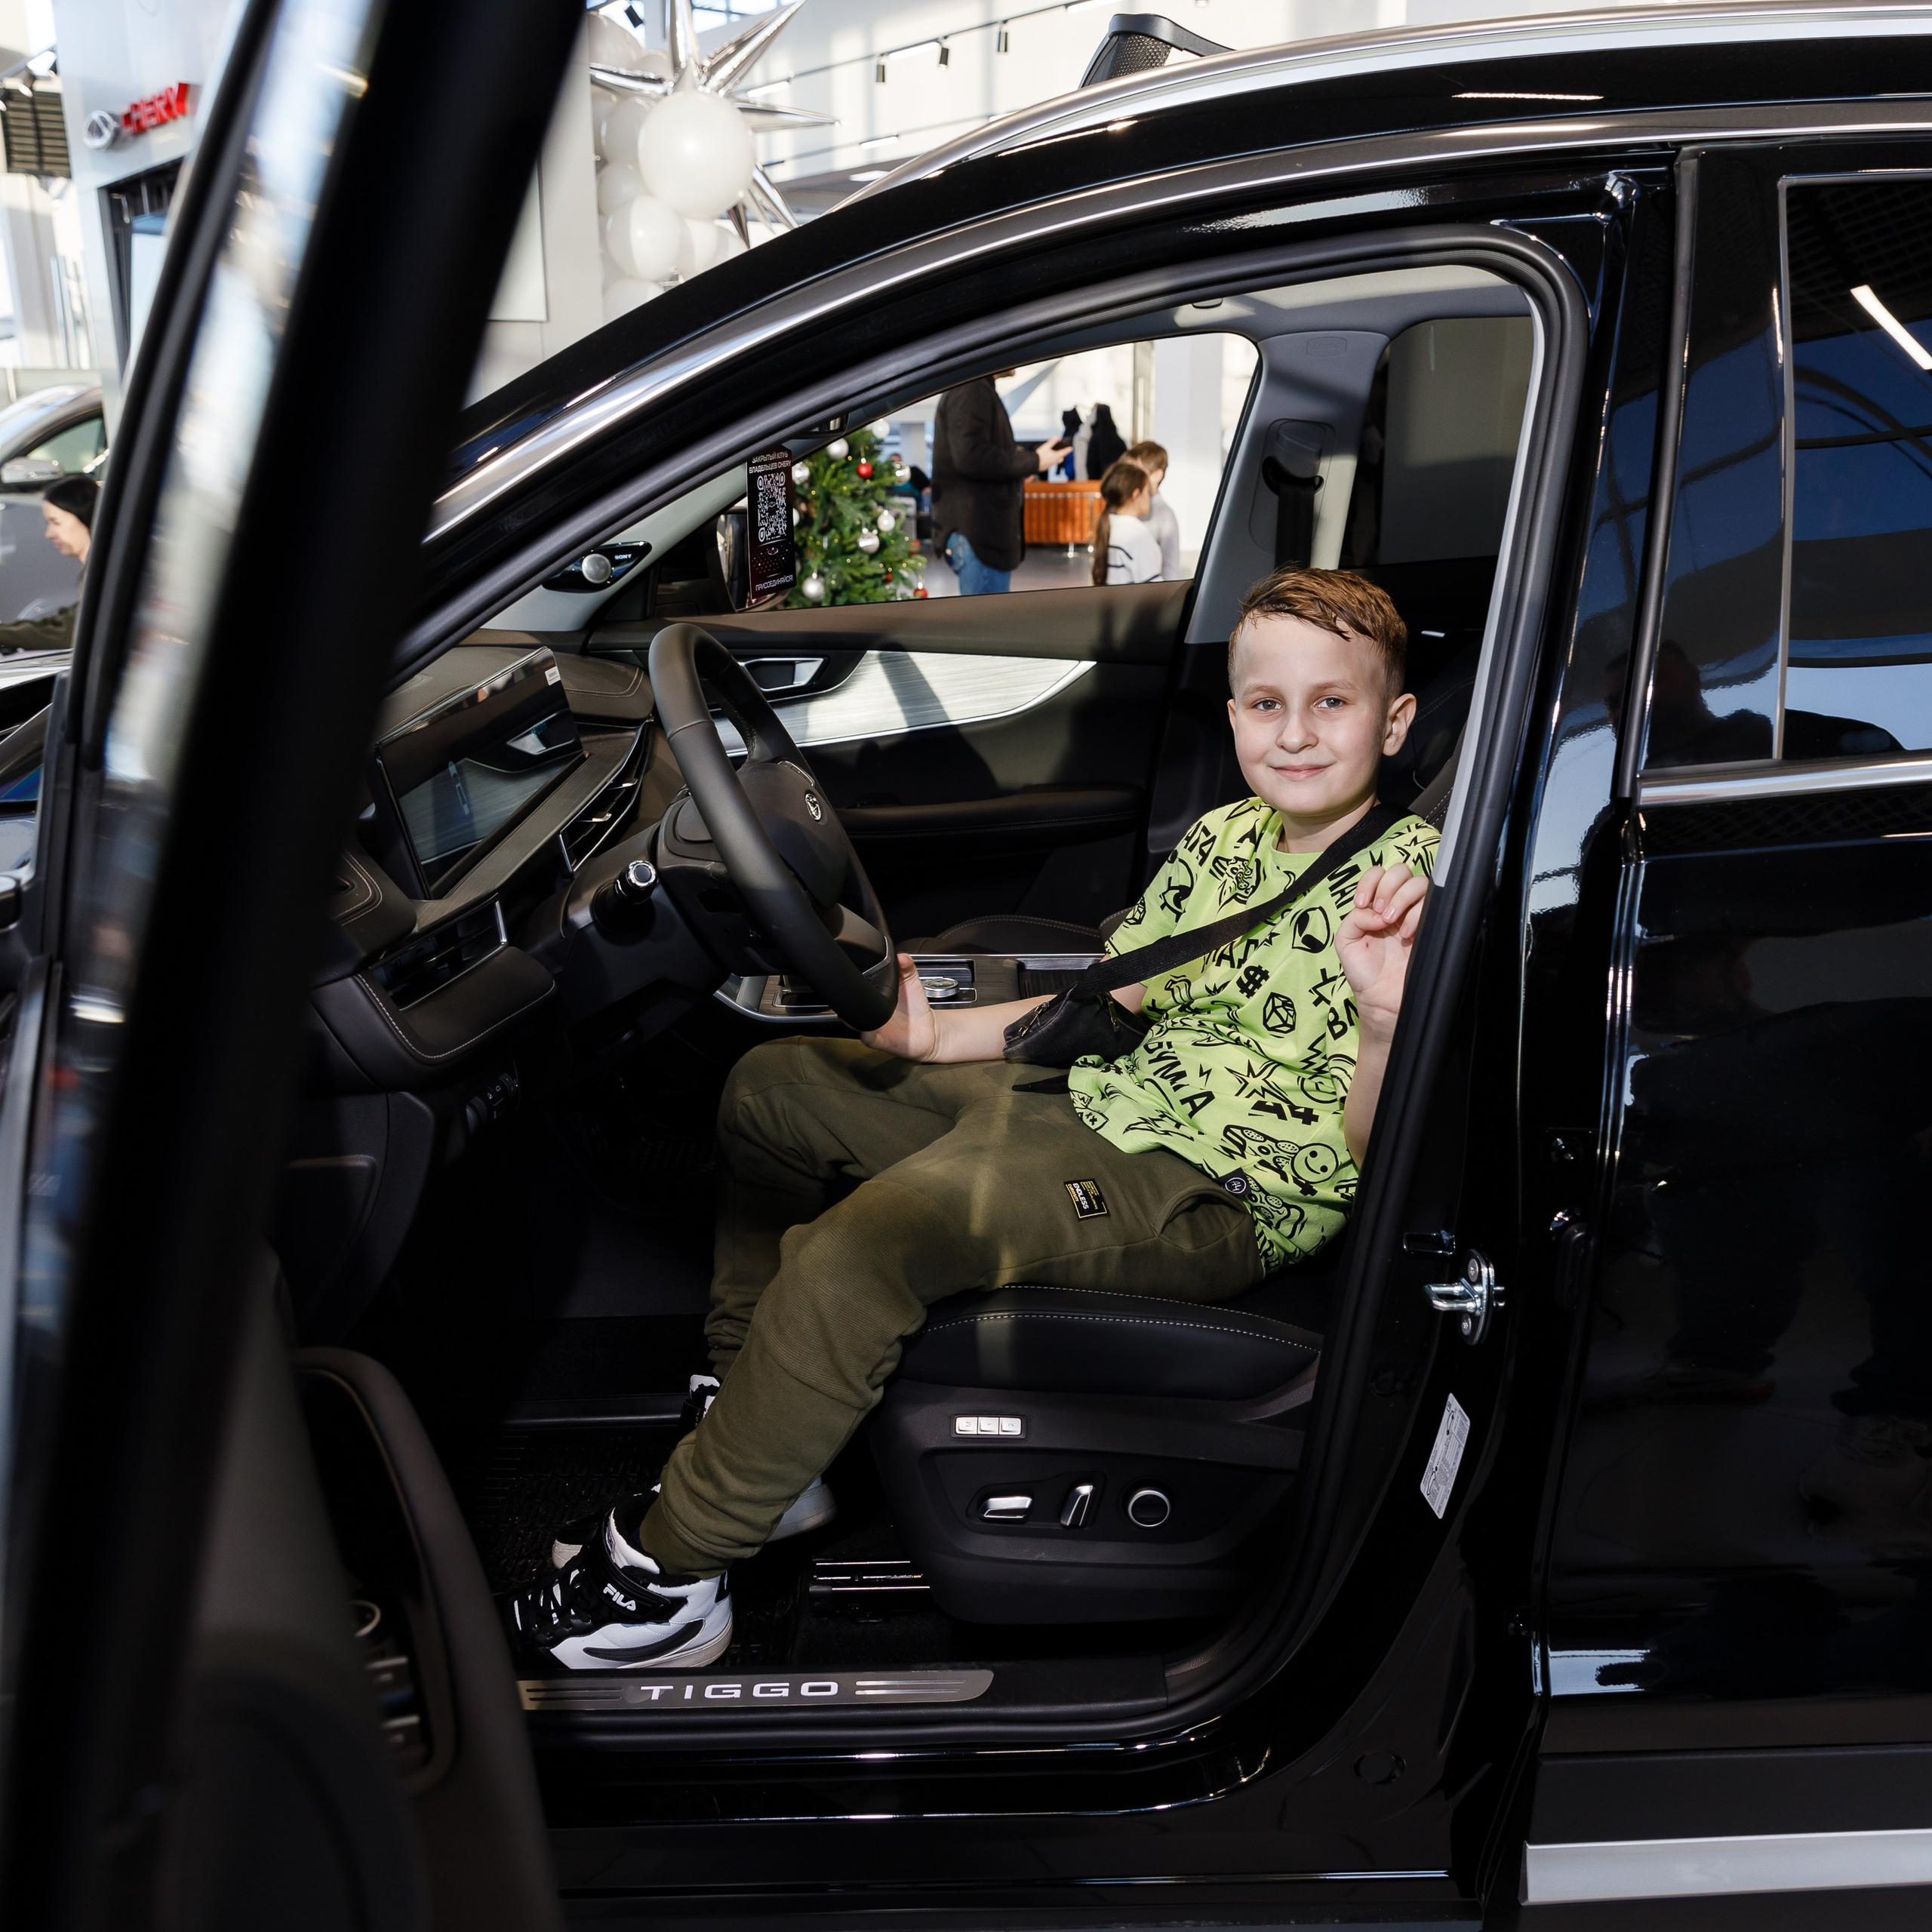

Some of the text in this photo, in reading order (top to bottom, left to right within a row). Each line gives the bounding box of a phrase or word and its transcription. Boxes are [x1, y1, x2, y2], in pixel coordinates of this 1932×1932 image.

[749, 460, 792, 474] ВЛАДЕЛЬЦЕВ CHERY
[752, 453, 777, 463] ЗАКРЫТЫЙ
[1072, 1183, 1089, 1210] ENDLESS
[602, 1583, 636, 1611] FILA
[640, 1681, 838, 1700] TIGGO
